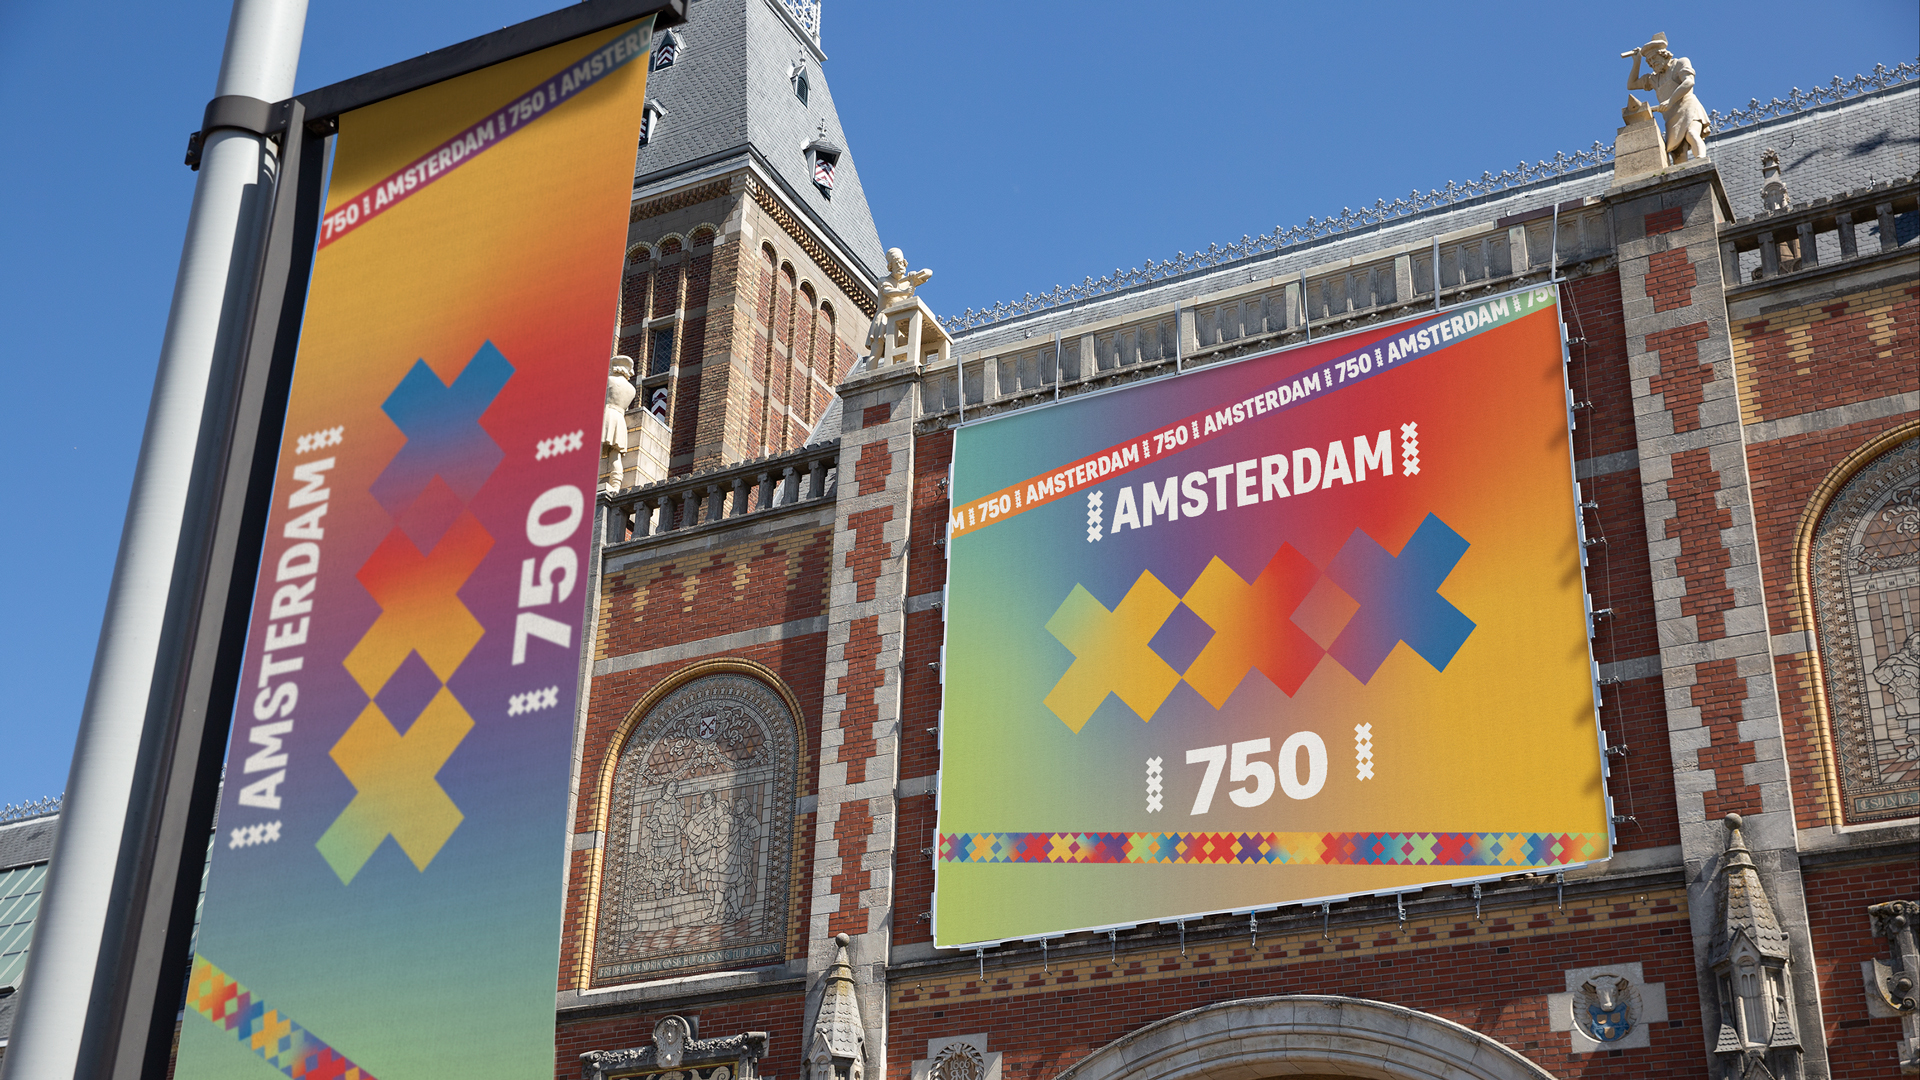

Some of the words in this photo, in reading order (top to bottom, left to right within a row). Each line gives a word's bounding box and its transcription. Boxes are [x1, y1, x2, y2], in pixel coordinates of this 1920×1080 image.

[323, 203, 360, 240] 750
[375, 120, 495, 210] AMSTERDAM
[508, 91, 546, 128] 750
[561, 25, 651, 97] AMSTERD
[978, 495, 1012, 523] 750
[1026, 443, 1139, 505] AMSTERDAM
[1153, 425, 1189, 455] 750
[1204, 372, 1321, 436] AMSTERDAM
[1334, 353, 1372, 383] 750
[1388, 297, 1510, 363] AMSTERDAM
[1110, 429, 1393, 534] AMSTERDAM
[238, 456, 336, 810] AMSTERDAM
[512, 484, 584, 666] 750
[1185, 731, 1328, 816] 750
[950, 1059, 970, 1070] 1606
